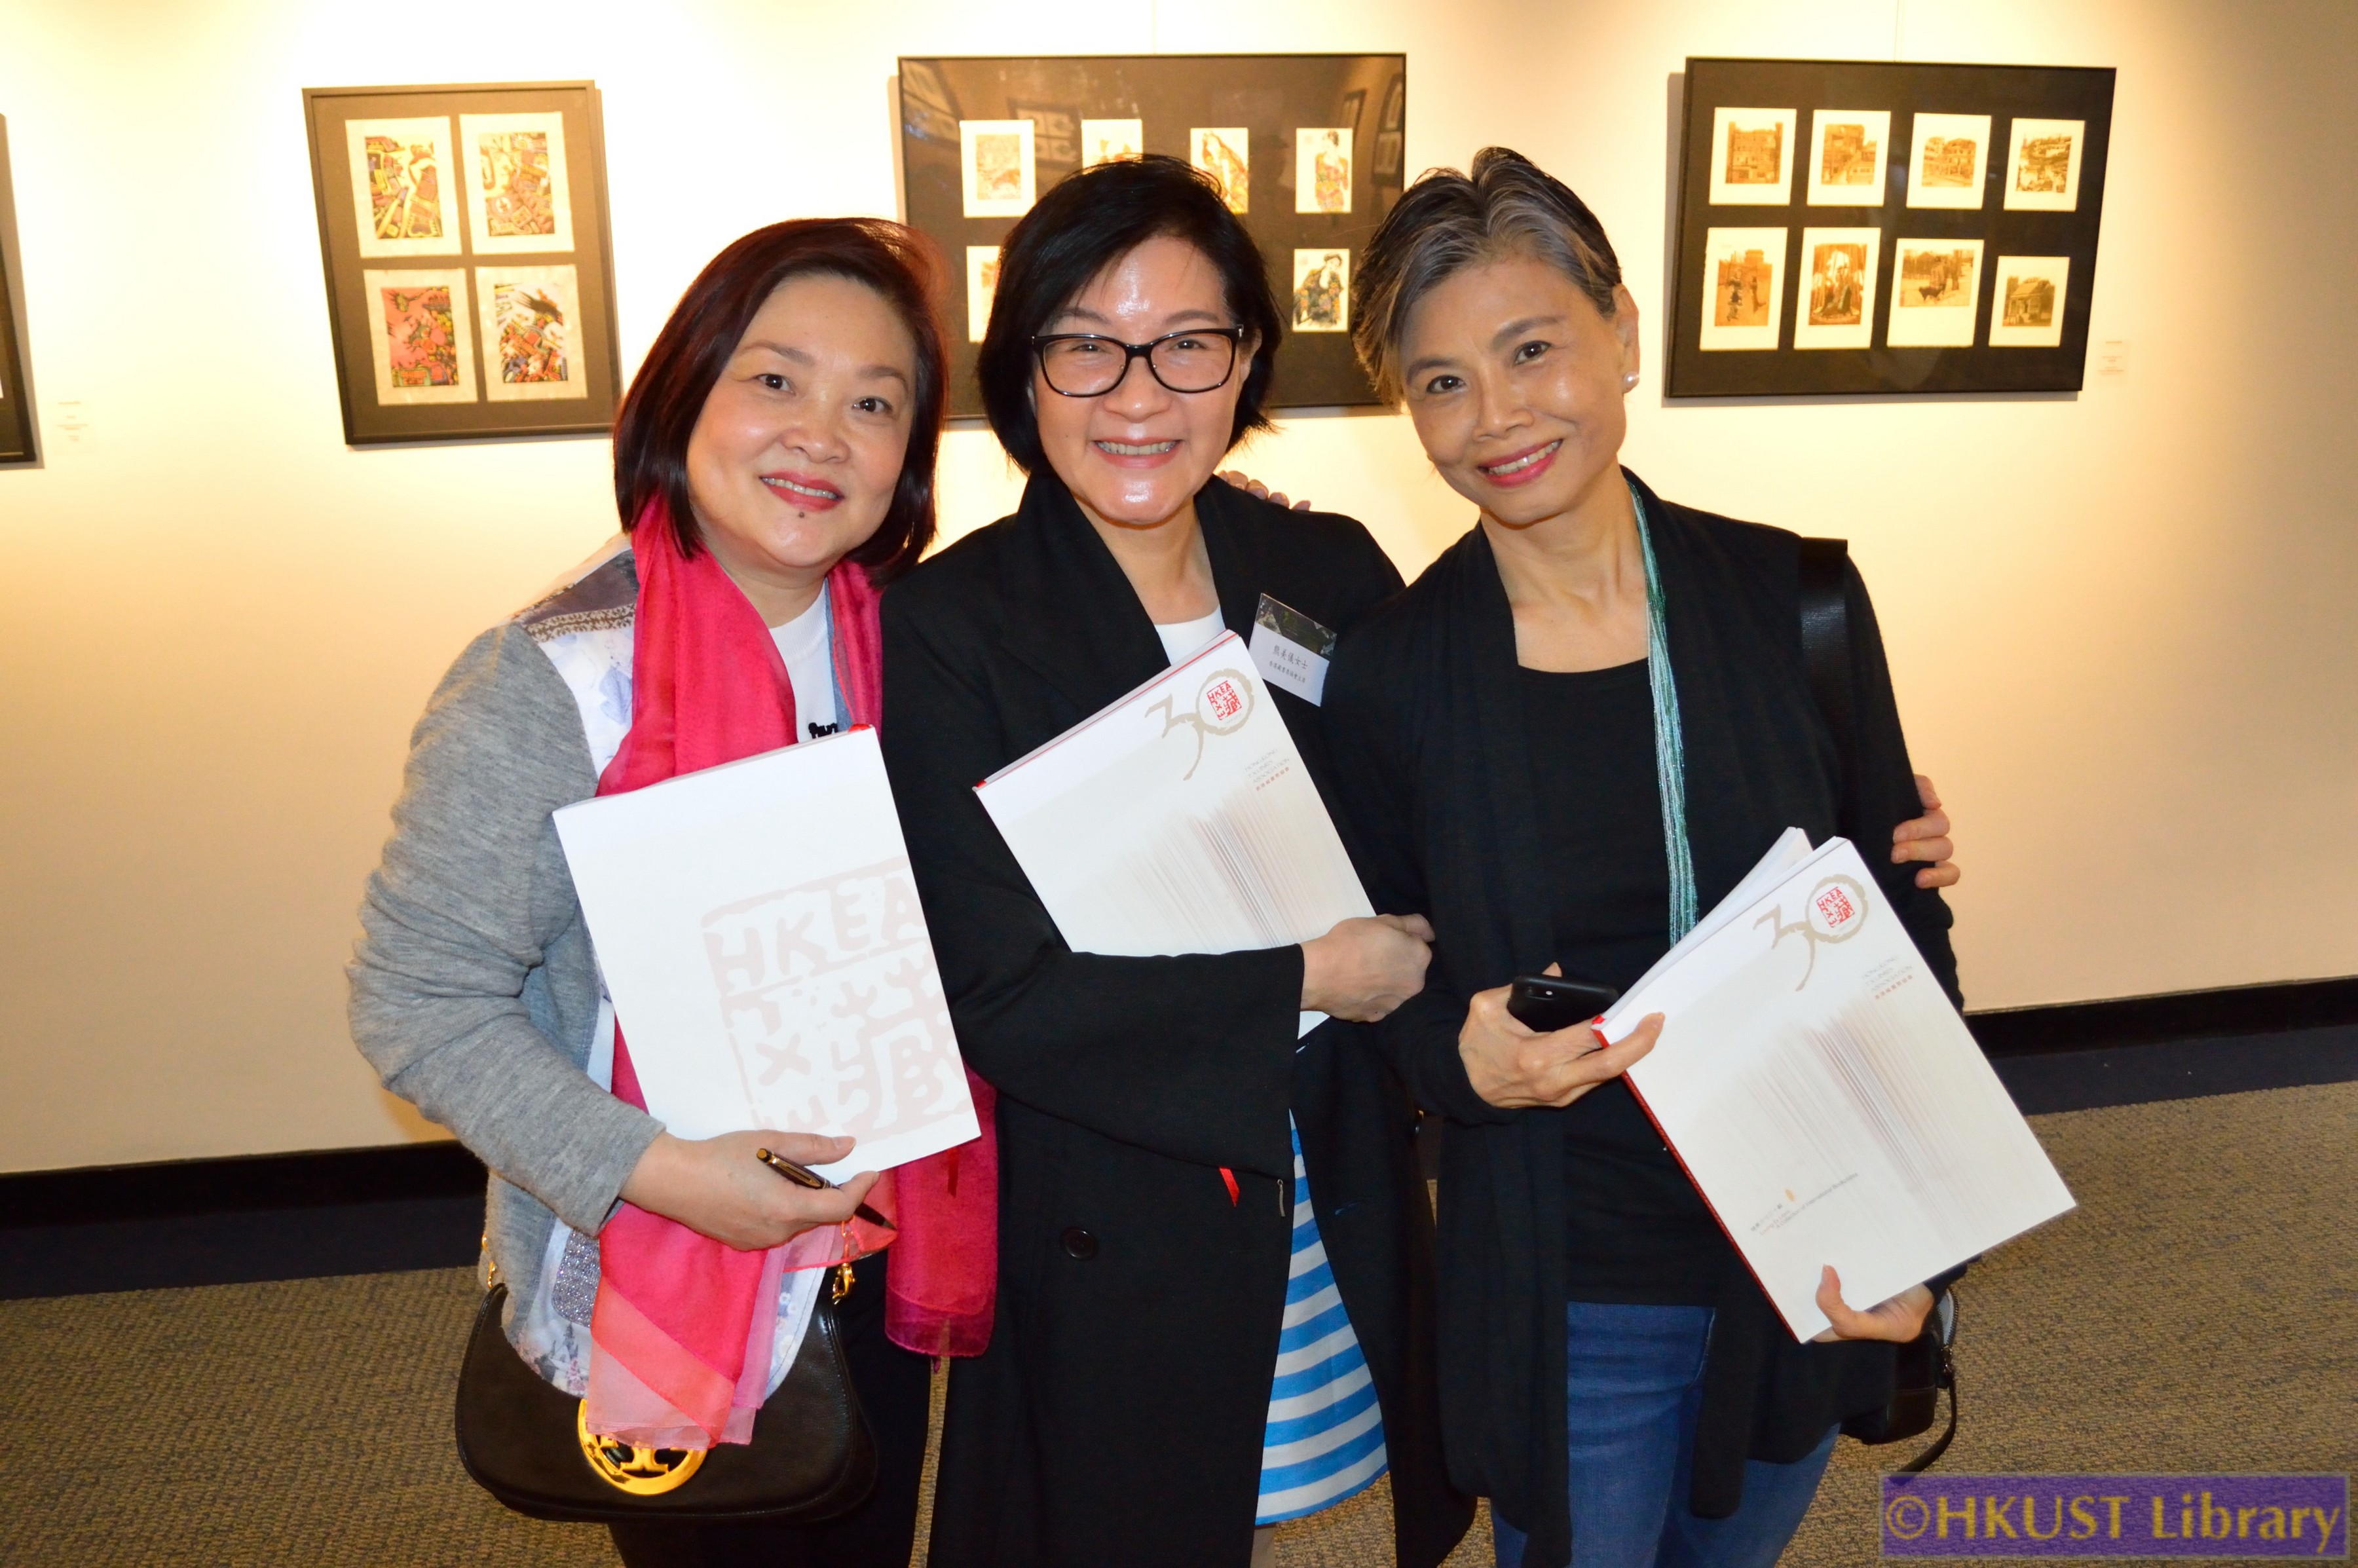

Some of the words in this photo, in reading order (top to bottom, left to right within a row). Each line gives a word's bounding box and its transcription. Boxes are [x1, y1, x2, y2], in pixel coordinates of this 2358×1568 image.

[1207, 682, 1231, 700] HKEA
[1817, 889, 1843, 908] HKEA
[704, 876, 925, 989] HKEA
